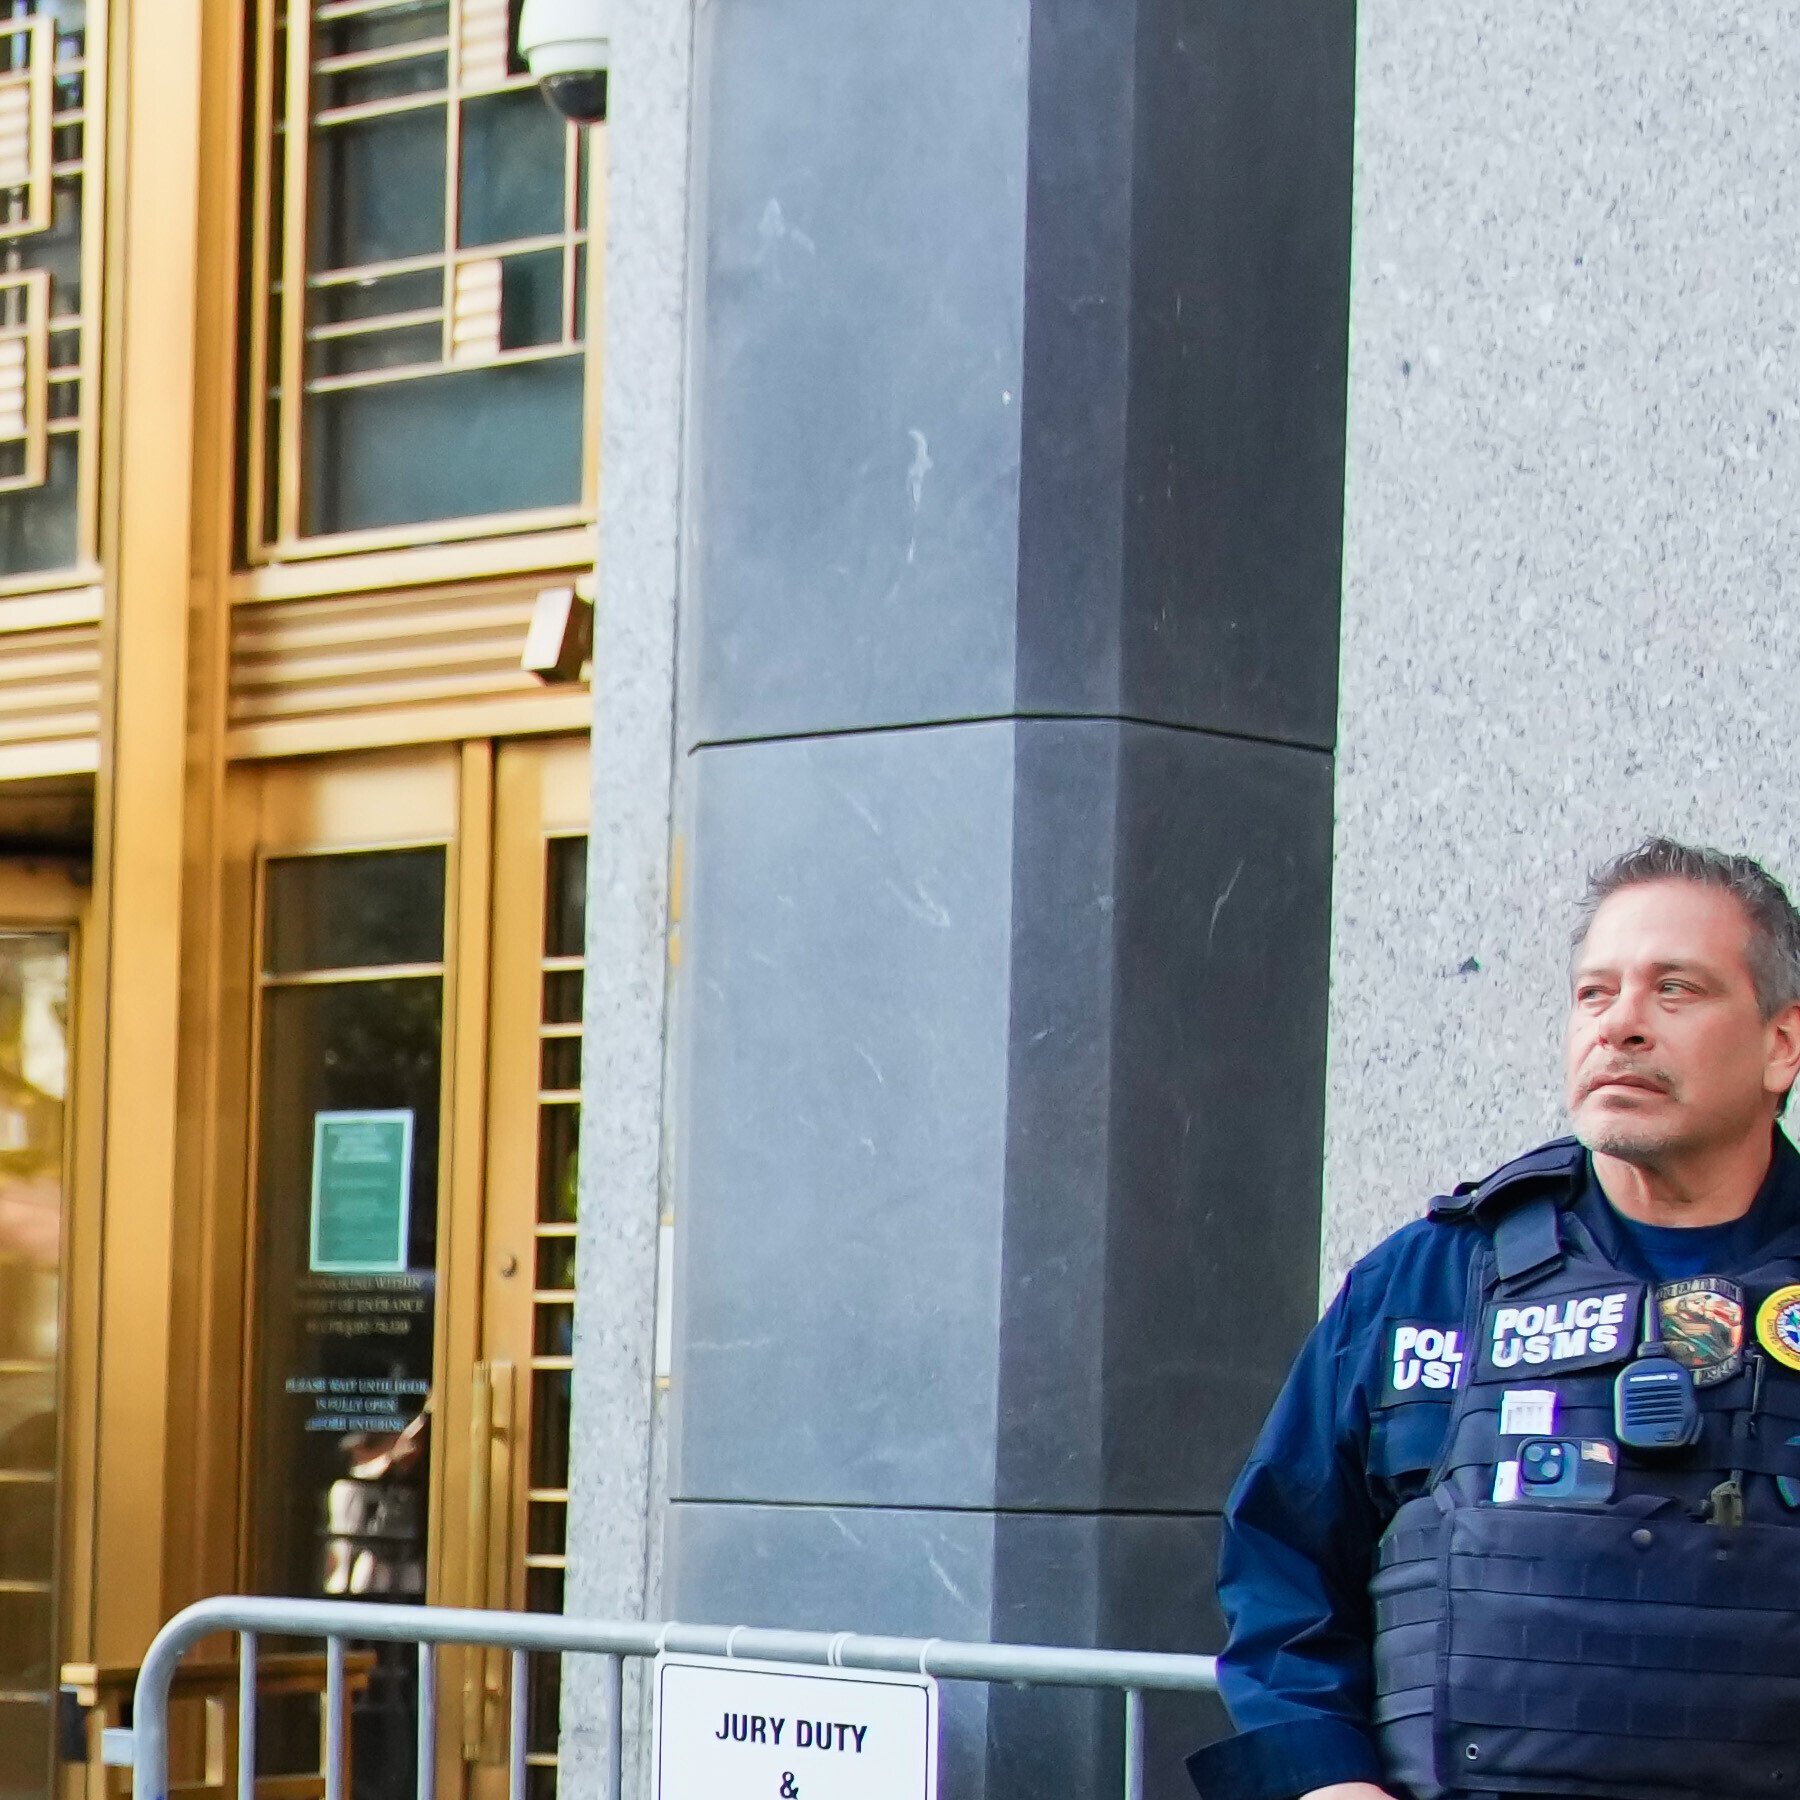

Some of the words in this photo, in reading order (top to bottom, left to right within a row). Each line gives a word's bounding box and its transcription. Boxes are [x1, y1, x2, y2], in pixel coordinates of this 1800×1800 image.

[1492, 1293, 1628, 1340] POLICE
[1491, 1325, 1619, 1368] USMS
[1392, 1359, 1462, 1391] US
[715, 1712, 786, 1745] JURY
[796, 1719, 868, 1753] DUTY
[779, 1771, 799, 1800] &
